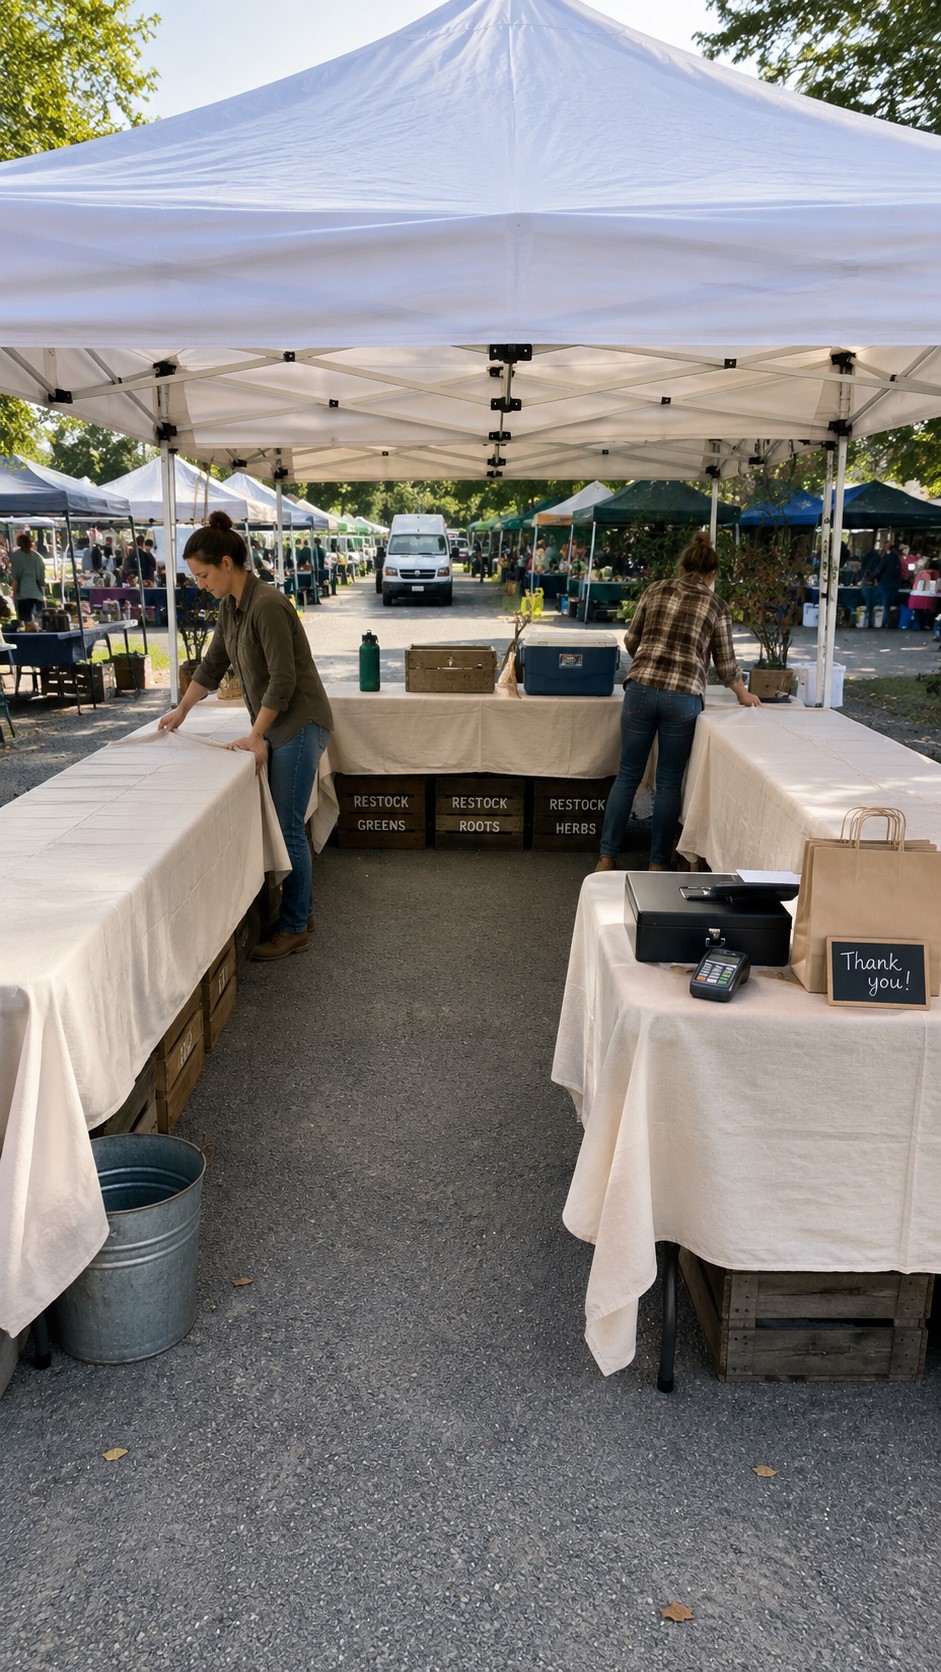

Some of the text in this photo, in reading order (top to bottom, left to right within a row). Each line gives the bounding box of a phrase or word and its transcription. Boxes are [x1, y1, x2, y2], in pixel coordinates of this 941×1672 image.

[354, 796, 409, 808] RESTOCK
[452, 796, 508, 809] RESTOCK
[549, 798, 605, 811] RESTOCK
[357, 820, 406, 831] GREENS
[459, 820, 500, 833] ROOTS
[556, 822, 596, 835] HERBS
[840, 951, 902, 971] Thank
[868, 970, 910, 996] you!
